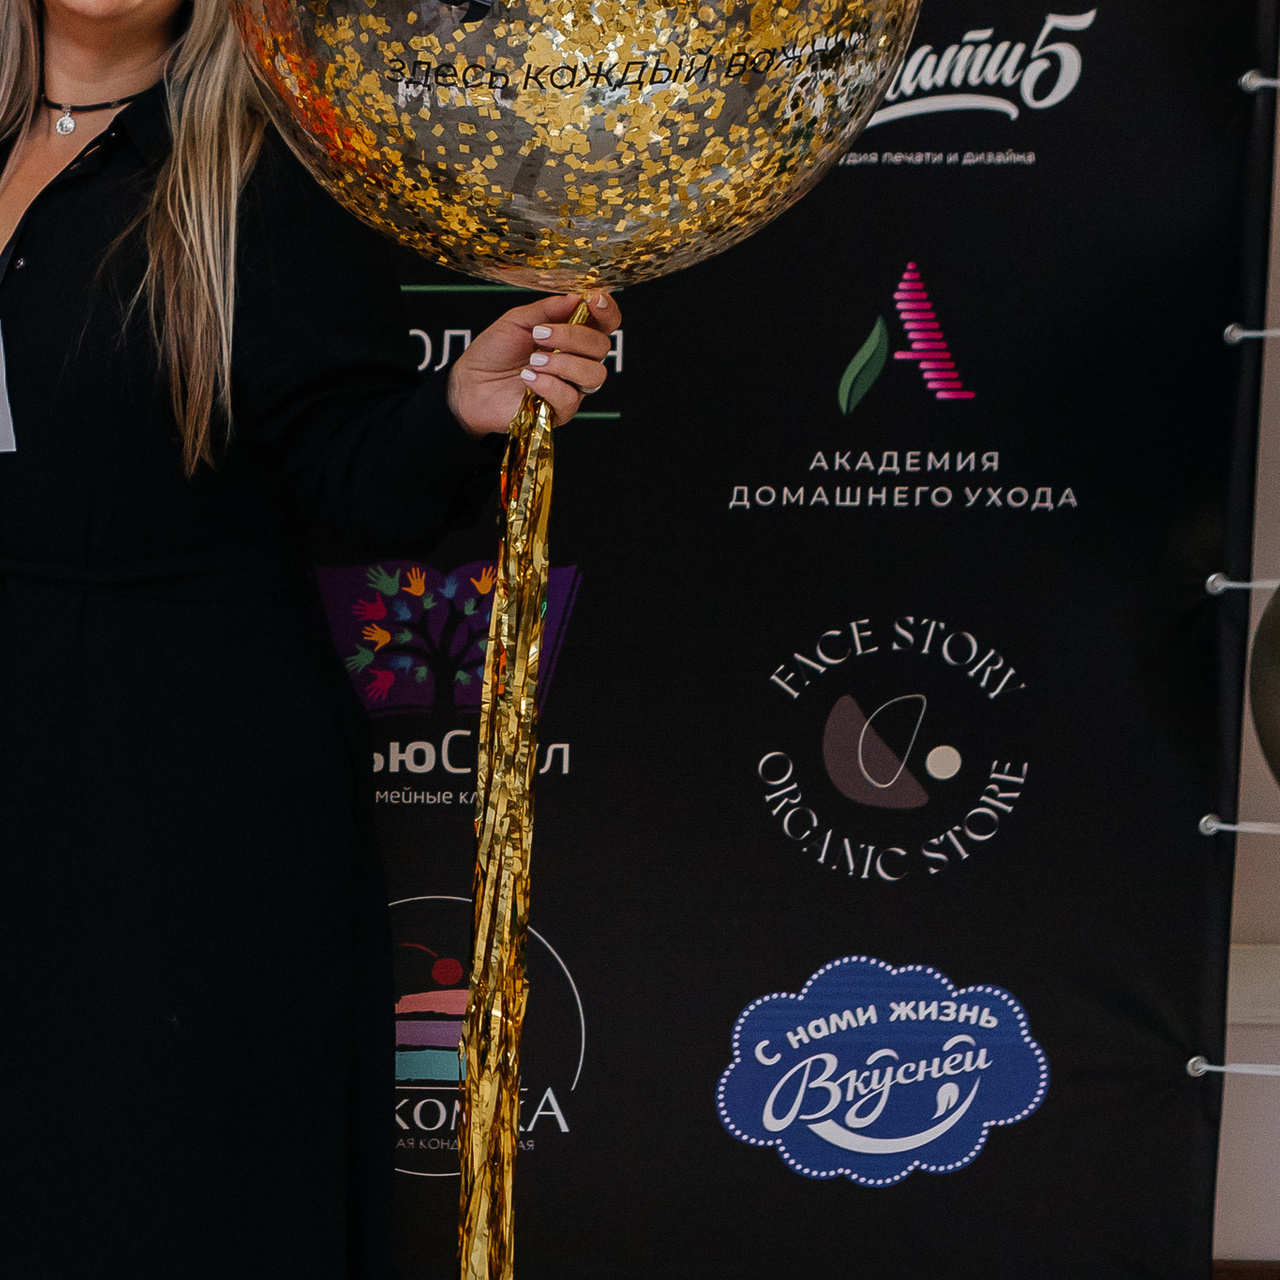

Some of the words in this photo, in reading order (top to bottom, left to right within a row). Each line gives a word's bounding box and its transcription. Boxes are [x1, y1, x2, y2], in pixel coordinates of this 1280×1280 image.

[385, 58, 510, 91] здесь
[522, 48, 710, 93] каждый
[809, 451, 999, 475] АКАДЕМИЯ
[728, 486, 953, 510] ДОМАШНЕГО
[964, 486, 1078, 511] УХОДА
[770, 618, 879, 699] FACE
[891, 615, 1027, 700] STORY
[375, 786, 454, 804] мейные
[758, 751, 910, 882] ORGANIC
[922, 760, 1029, 875] STORE
[786, 1003, 879, 1050] нами
[888, 999, 1000, 1029] жизнь
